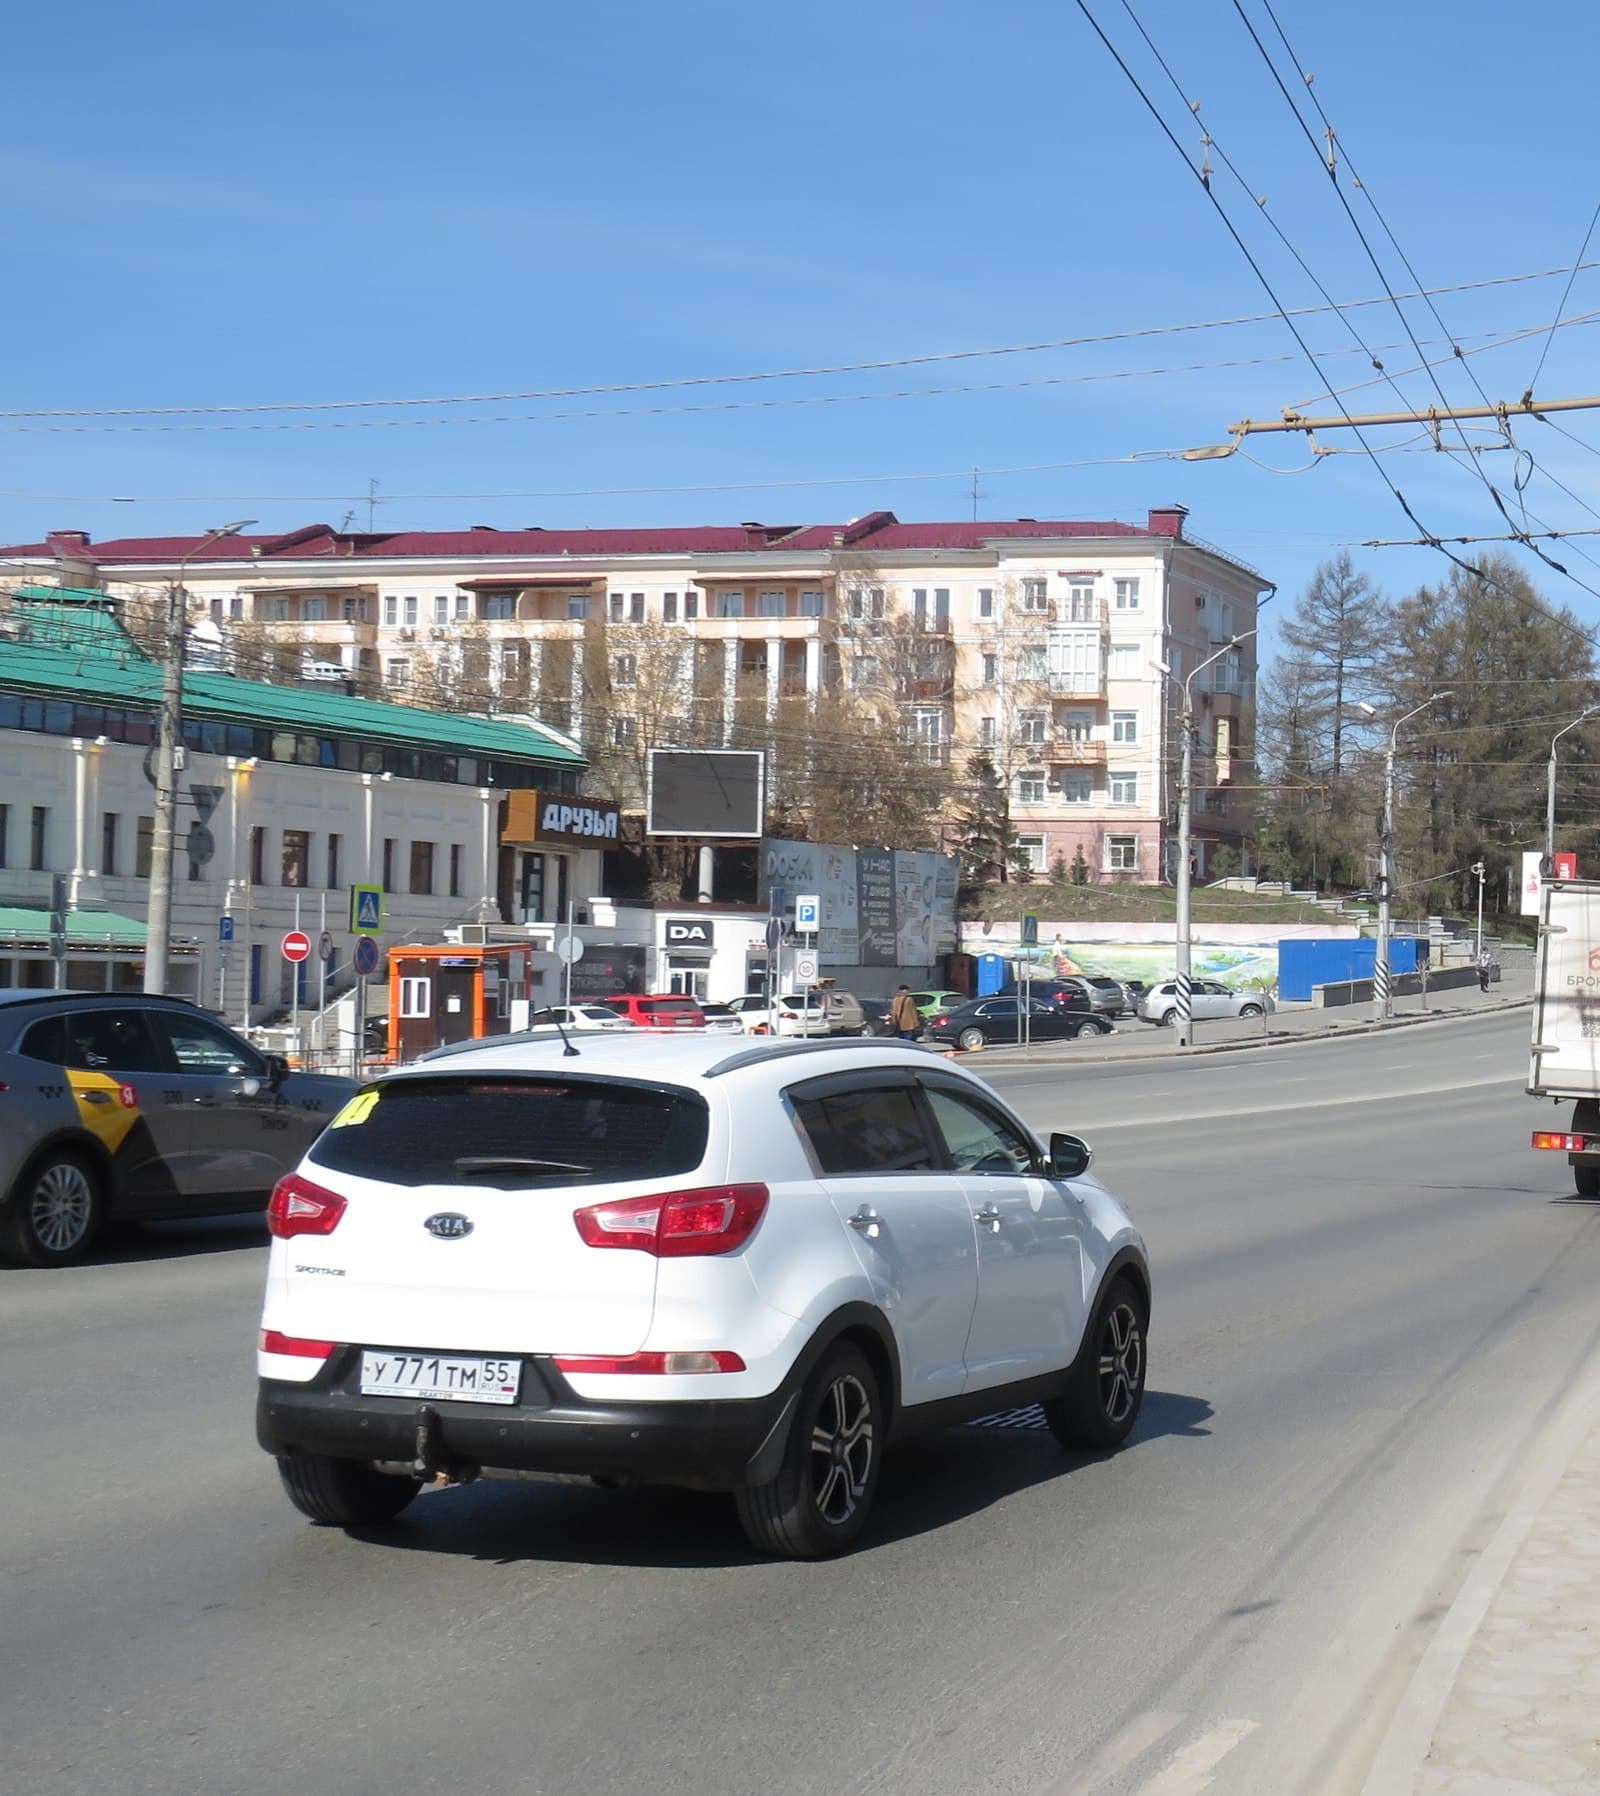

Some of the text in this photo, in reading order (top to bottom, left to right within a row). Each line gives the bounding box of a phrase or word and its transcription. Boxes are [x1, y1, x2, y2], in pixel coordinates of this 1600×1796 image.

[542, 803, 618, 839] ДРУЗЬЯ
[669, 926, 706, 940] DA
[483, 1361, 509, 1383] 55
[480, 1383, 500, 1392] RUS
